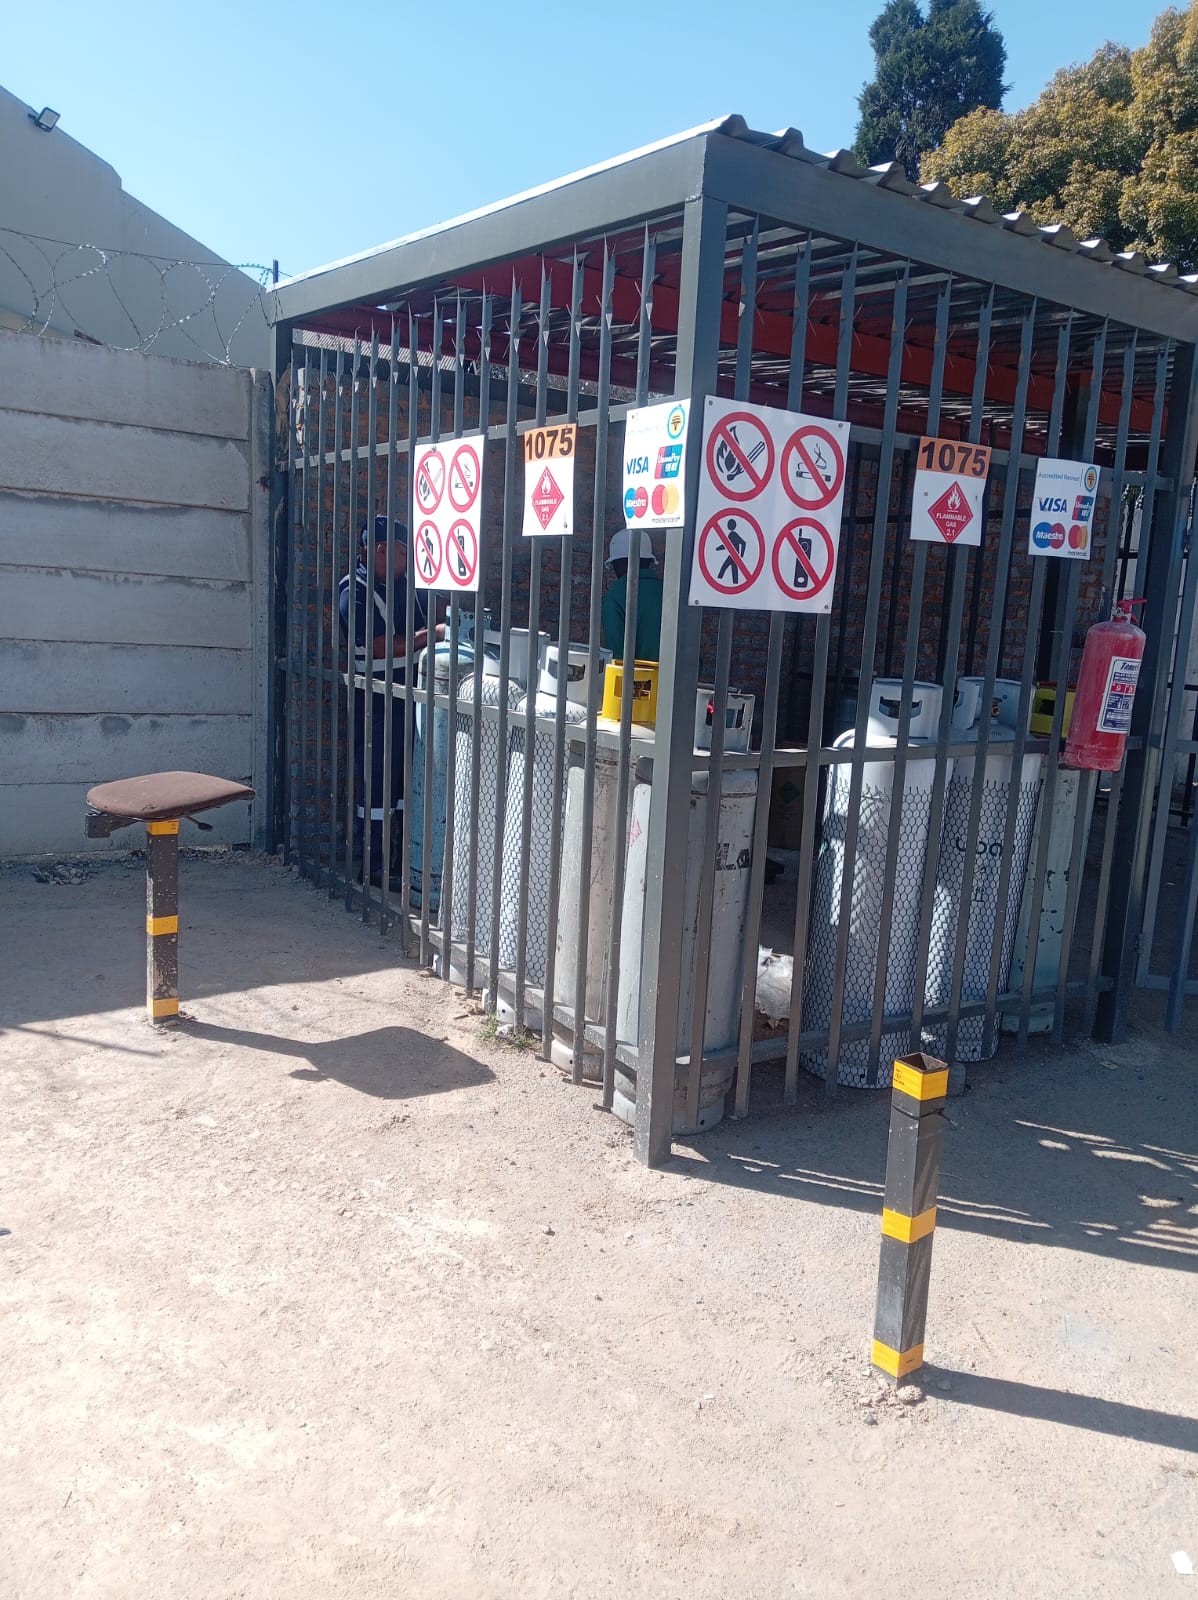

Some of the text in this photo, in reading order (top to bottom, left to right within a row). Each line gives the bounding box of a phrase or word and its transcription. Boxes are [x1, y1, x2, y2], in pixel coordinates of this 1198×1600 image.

[526, 427, 573, 460] 1075
[626, 455, 649, 475] VISA
[922, 441, 987, 476] 1075
[1039, 497, 1068, 512] VISA
[936, 512, 967, 521] FLAMMABLE
[1035, 531, 1064, 540] Maestro
